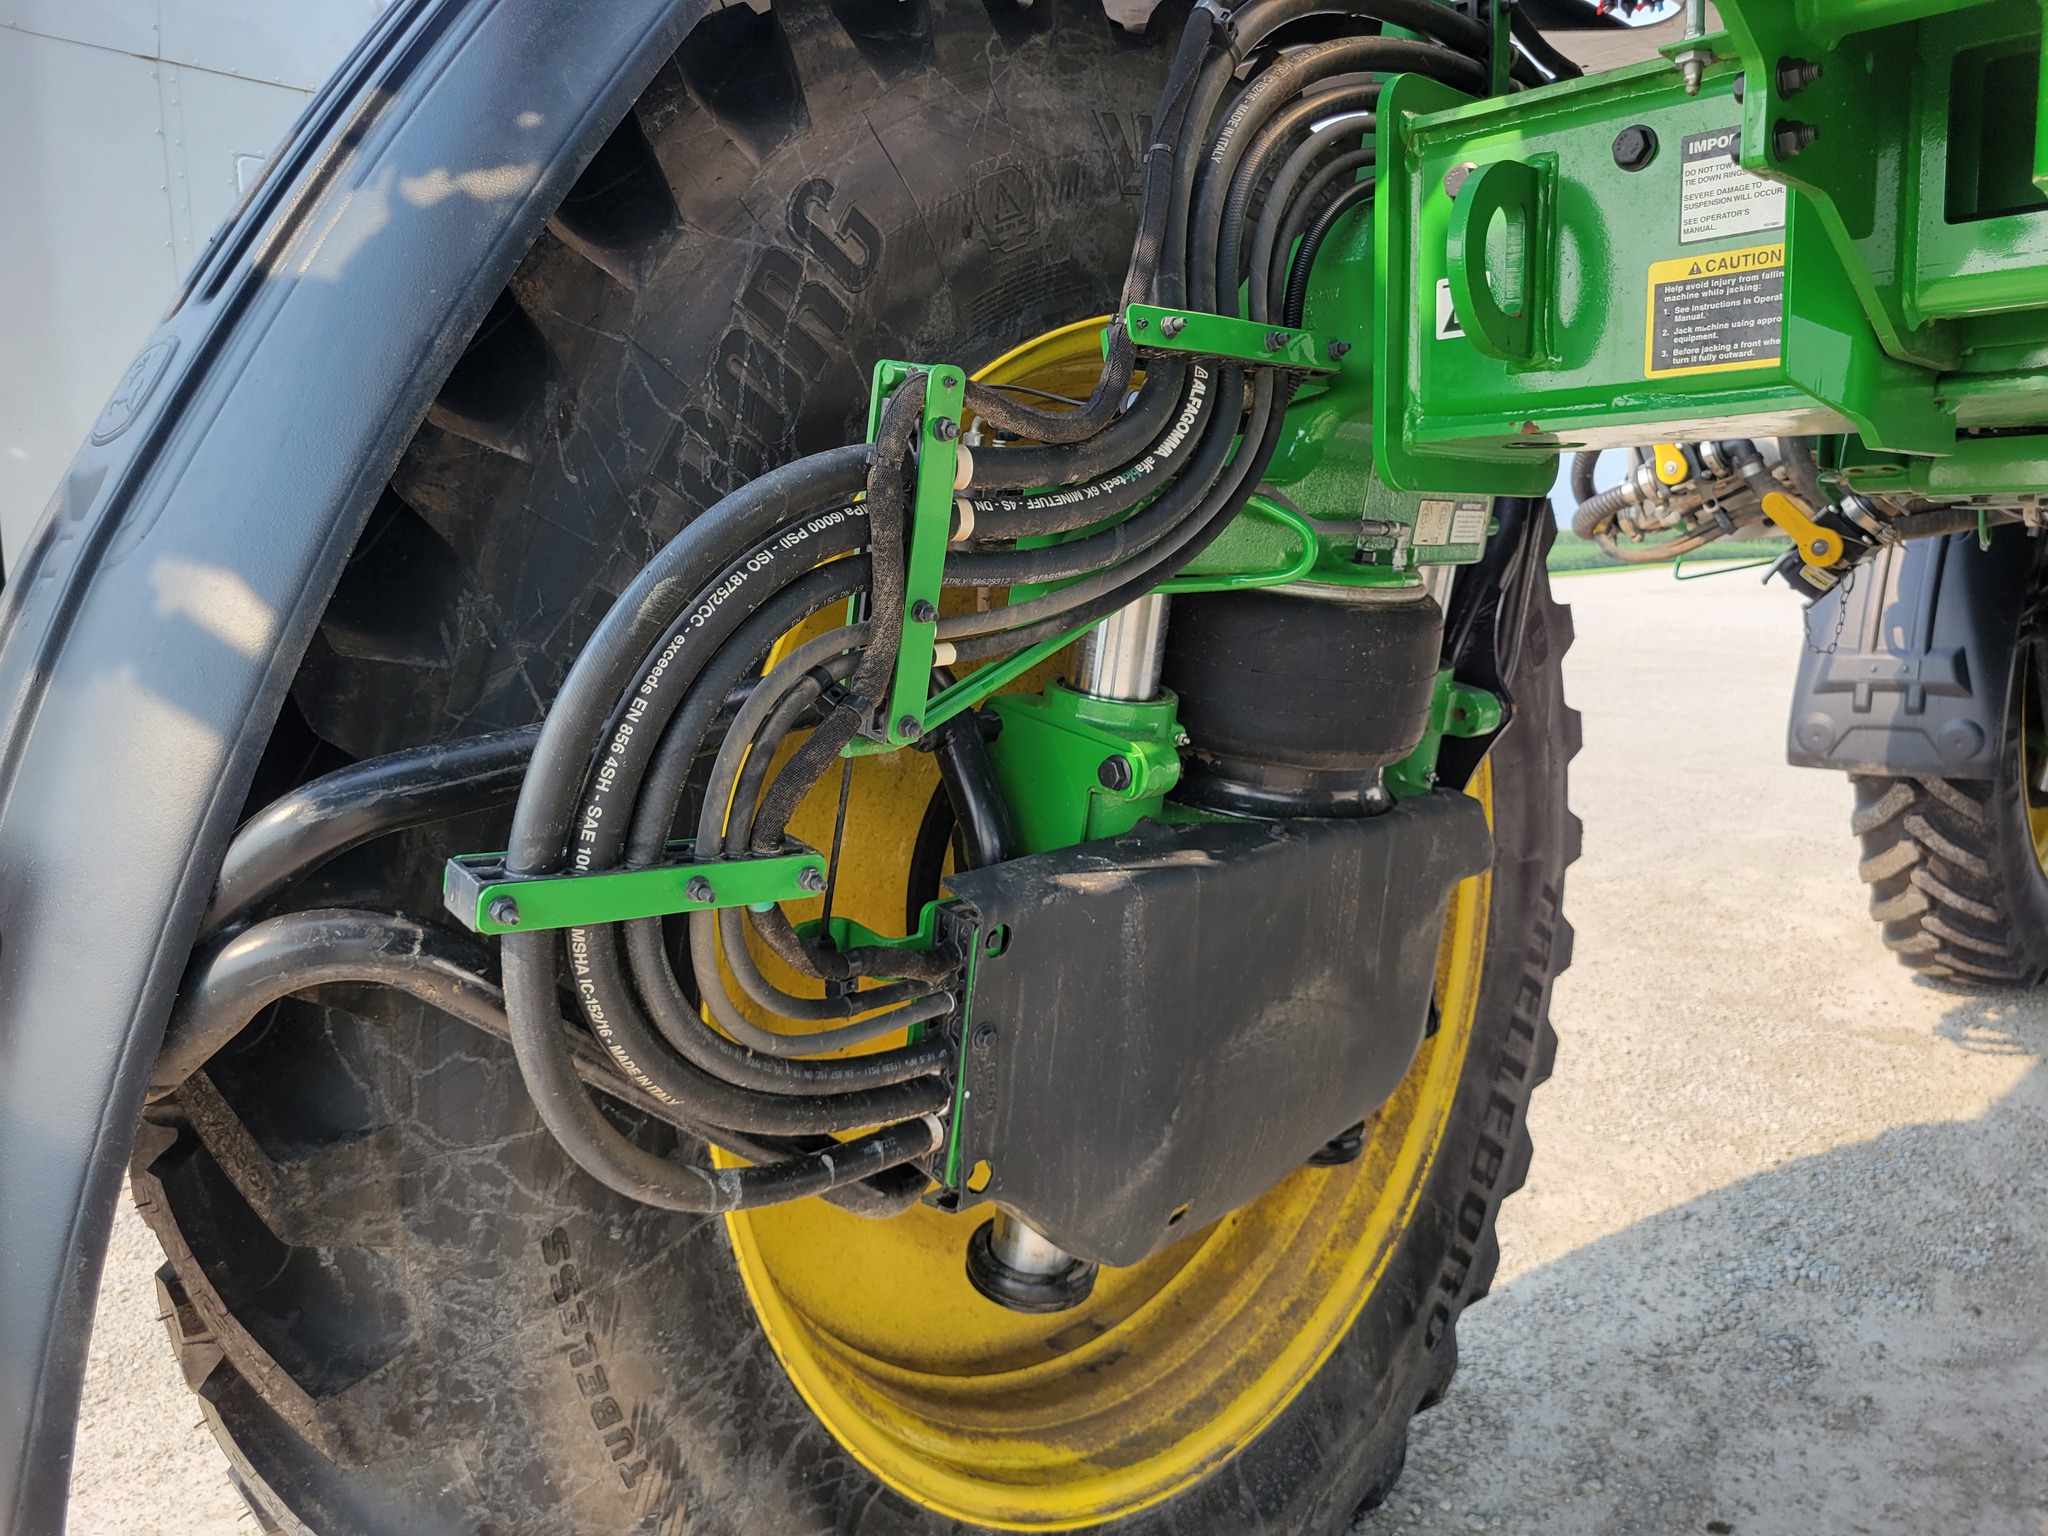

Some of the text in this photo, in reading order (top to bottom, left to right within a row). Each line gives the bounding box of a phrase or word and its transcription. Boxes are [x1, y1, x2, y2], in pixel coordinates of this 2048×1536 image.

[1227, 104, 1250, 130] MADE
[1222, 126, 1235, 138] IN
[1210, 135, 1230, 164] ITALY
[1685, 169, 1696, 177] DO
[1698, 166, 1713, 174] NOT
[1714, 162, 1732, 171] TOW
[1685, 178, 1696, 186] TIE
[1698, 174, 1720, 184] DOWN
[1684, 190, 1714, 202] SEVERE
[1716, 184, 1750, 196] DAMAGE
[1684, 187, 1784, 210] SUSPENSION WILL OCCUR.
[1684, 218, 1698, 226] SEE
[1700, 208, 1750, 224] OPERATOR'S
[1683, 226, 1717, 235] MANUAL.
[1706, 249, 1782, 272] CAUTION
[1664, 270, 1784, 294] Help avoid injury from fallin
[1664, 284, 1762, 302] machine while jacking:
[1674, 306, 1690, 314] See
[1692, 300, 1740, 312] instructions
[1754, 293, 1782, 304] Operat
[1674, 312, 1706, 322] Manual.
[1674, 325, 1692, 335] Jack
[1694, 322, 1729, 332] machine
[1732, 318, 1754, 328] using
[1756, 316, 1782, 326] appro
[1672, 346, 1700, 356] Before
[1701, 343, 1731, 354] jacking
[1740, 339, 1762, 348] front
[1763, 338, 1780, 346] whe
[1674, 332, 1718, 344] equipment.
[1672, 356, 1689, 364] turn
[1698, 352, 1716, 362] fully
[1718, 349, 1755, 360] outward.
[1153, 378, 1206, 458] ALFAGOMMA
[1028, 492, 1084, 510] MINETUFF
[1087, 486, 1100, 498] 6K
[844, 503, 868, 516] MPa
[974, 500, 994, 512] DN
[1001, 500, 1016, 511] 4S
[807, 512, 845, 533] (6000
[780, 528, 810, 550] PSI)
[746, 549, 774, 572] ISO
[690, 571, 748, 628] 18752/CC
[640, 634, 686, 694] exceeds
[626, 697, 648, 722] EN
[611, 724, 634, 754] 856
[596, 758, 619, 793] 4SH
[580, 805, 602, 842] SAE
[571, 928, 590, 976] MSHA
[578, 978, 613, 1038] IC-152/16
[610, 1044, 642, 1077] MADE
[634, 1074, 652, 1088] IN
[648, 1082, 684, 1106] ITALY
[541, 1226, 648, 1489] TUBELESS
